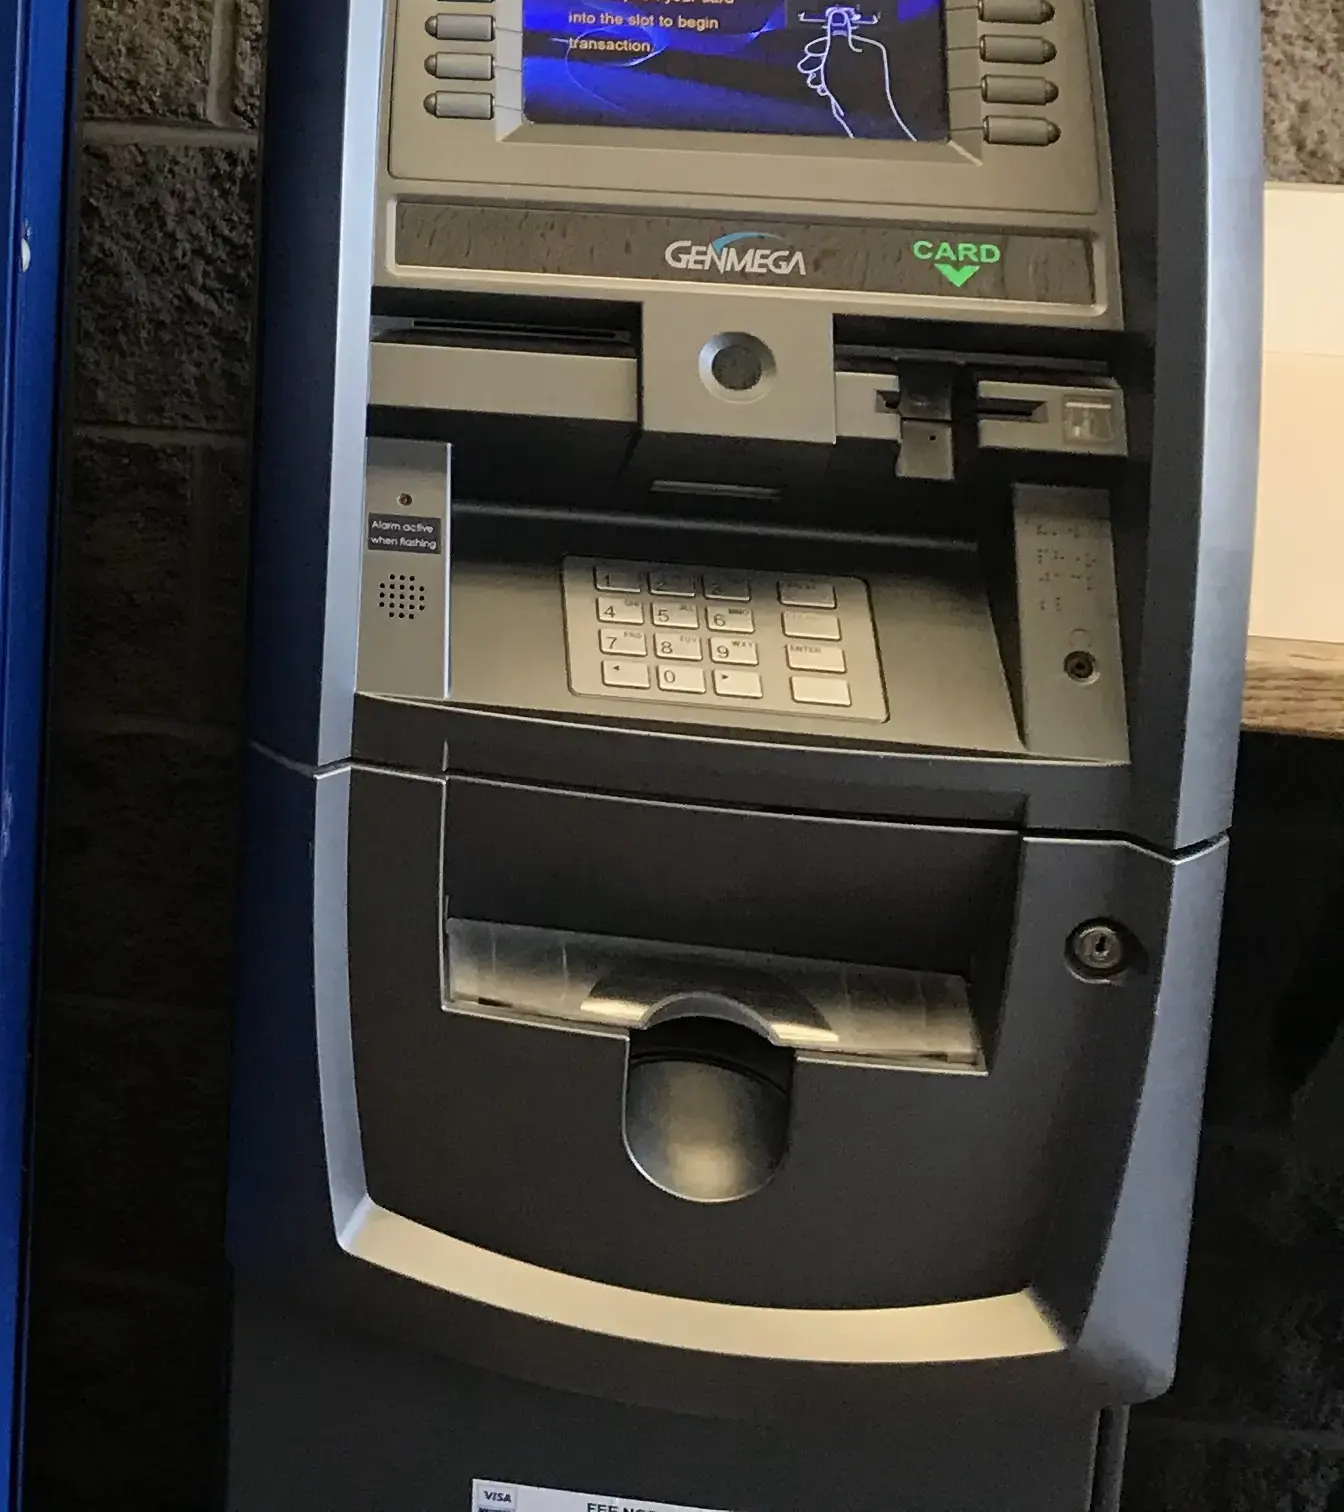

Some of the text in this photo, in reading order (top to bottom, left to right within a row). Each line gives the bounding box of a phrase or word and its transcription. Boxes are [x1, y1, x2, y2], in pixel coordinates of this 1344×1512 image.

[569, 12, 719, 32] into the slot to begin
[569, 37, 653, 52] transaction.
[664, 239, 807, 276] GENMEGA
[913, 240, 1000, 264] CARD
[371, 521, 433, 533] Alarm active
[371, 536, 437, 550] when flashing
[605, 574, 610, 587] 1
[603, 605, 616, 618] 4
[657, 609, 669, 622] 5
[716, 614, 726, 627] 6
[607, 636, 617, 650] 7
[661, 641, 673, 655] 8
[790, 645, 822, 653] ENTER
[716, 645, 729, 659] 9
[663, 670, 676, 684] 0
[484, 1491, 512, 1503] VISA
